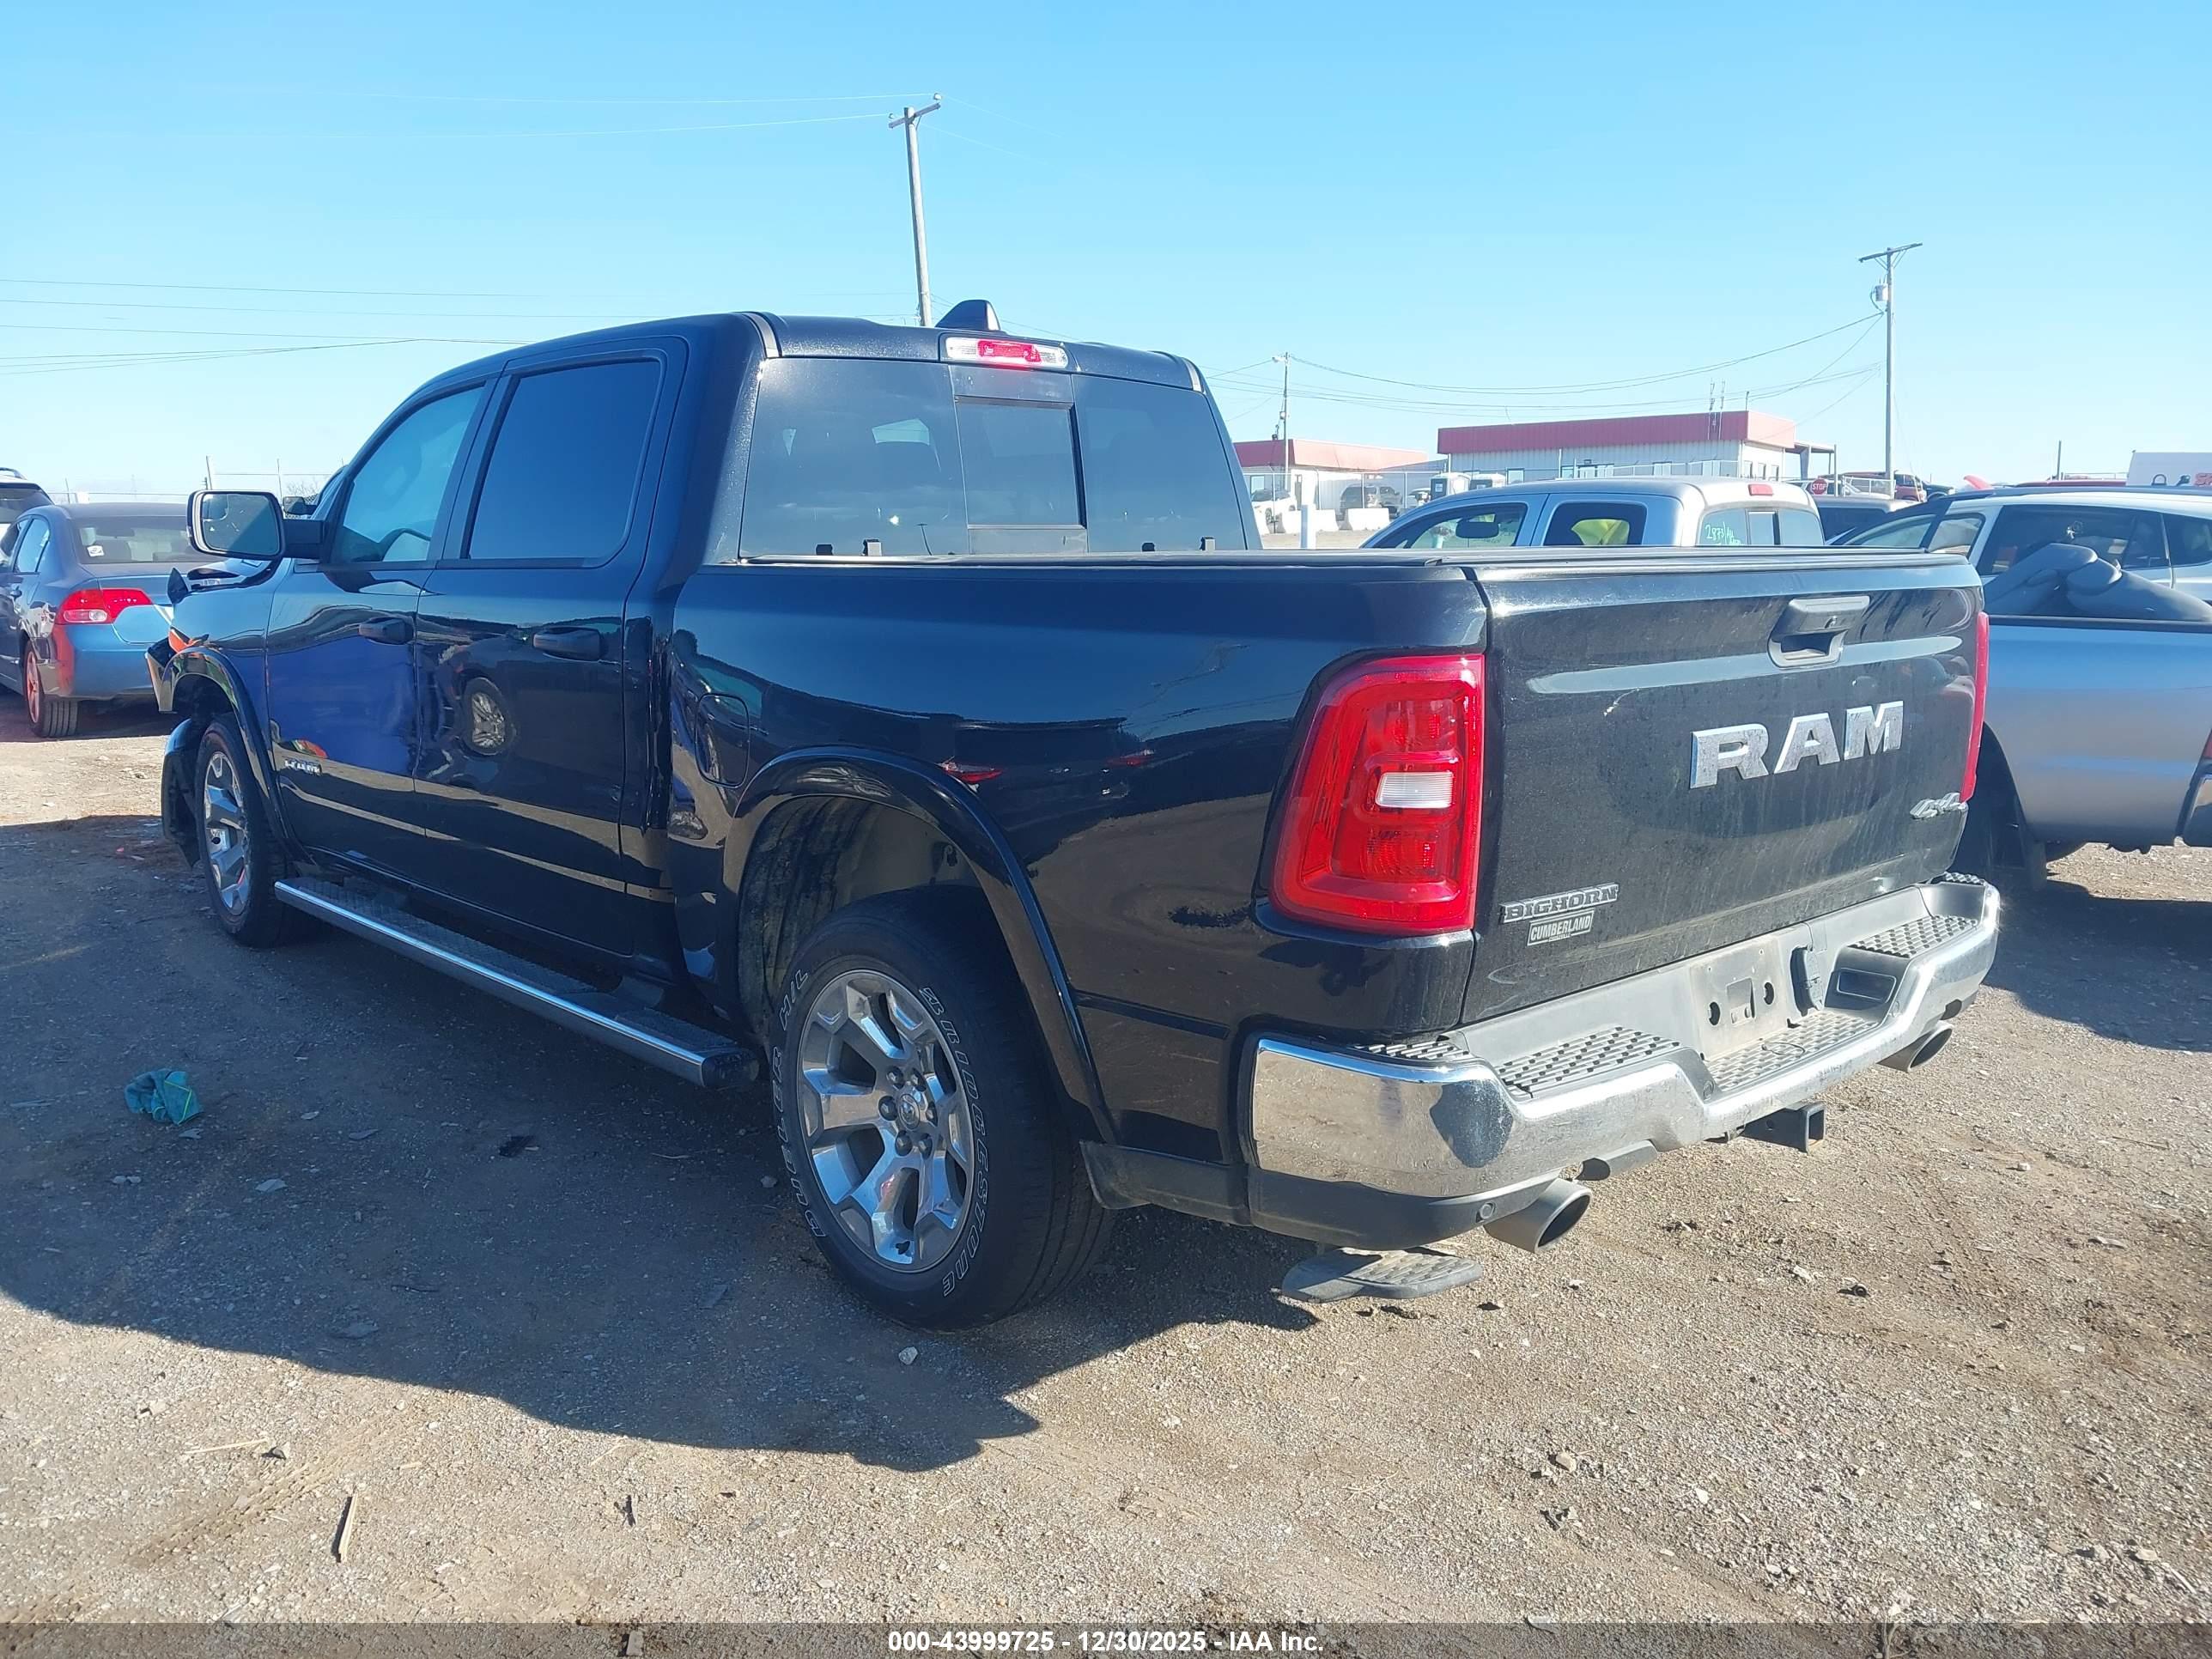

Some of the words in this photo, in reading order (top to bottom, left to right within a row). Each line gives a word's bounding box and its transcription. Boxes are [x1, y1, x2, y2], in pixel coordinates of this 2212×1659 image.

[1690, 701, 1904, 789] RAM
[1499, 882, 1620, 924] BIGHORN
[1530, 915, 1591, 941] CUMBERLAND
[773, 1046, 827, 1237] DUELER
[919, 987, 989, 1297] BRIDGESTONE
